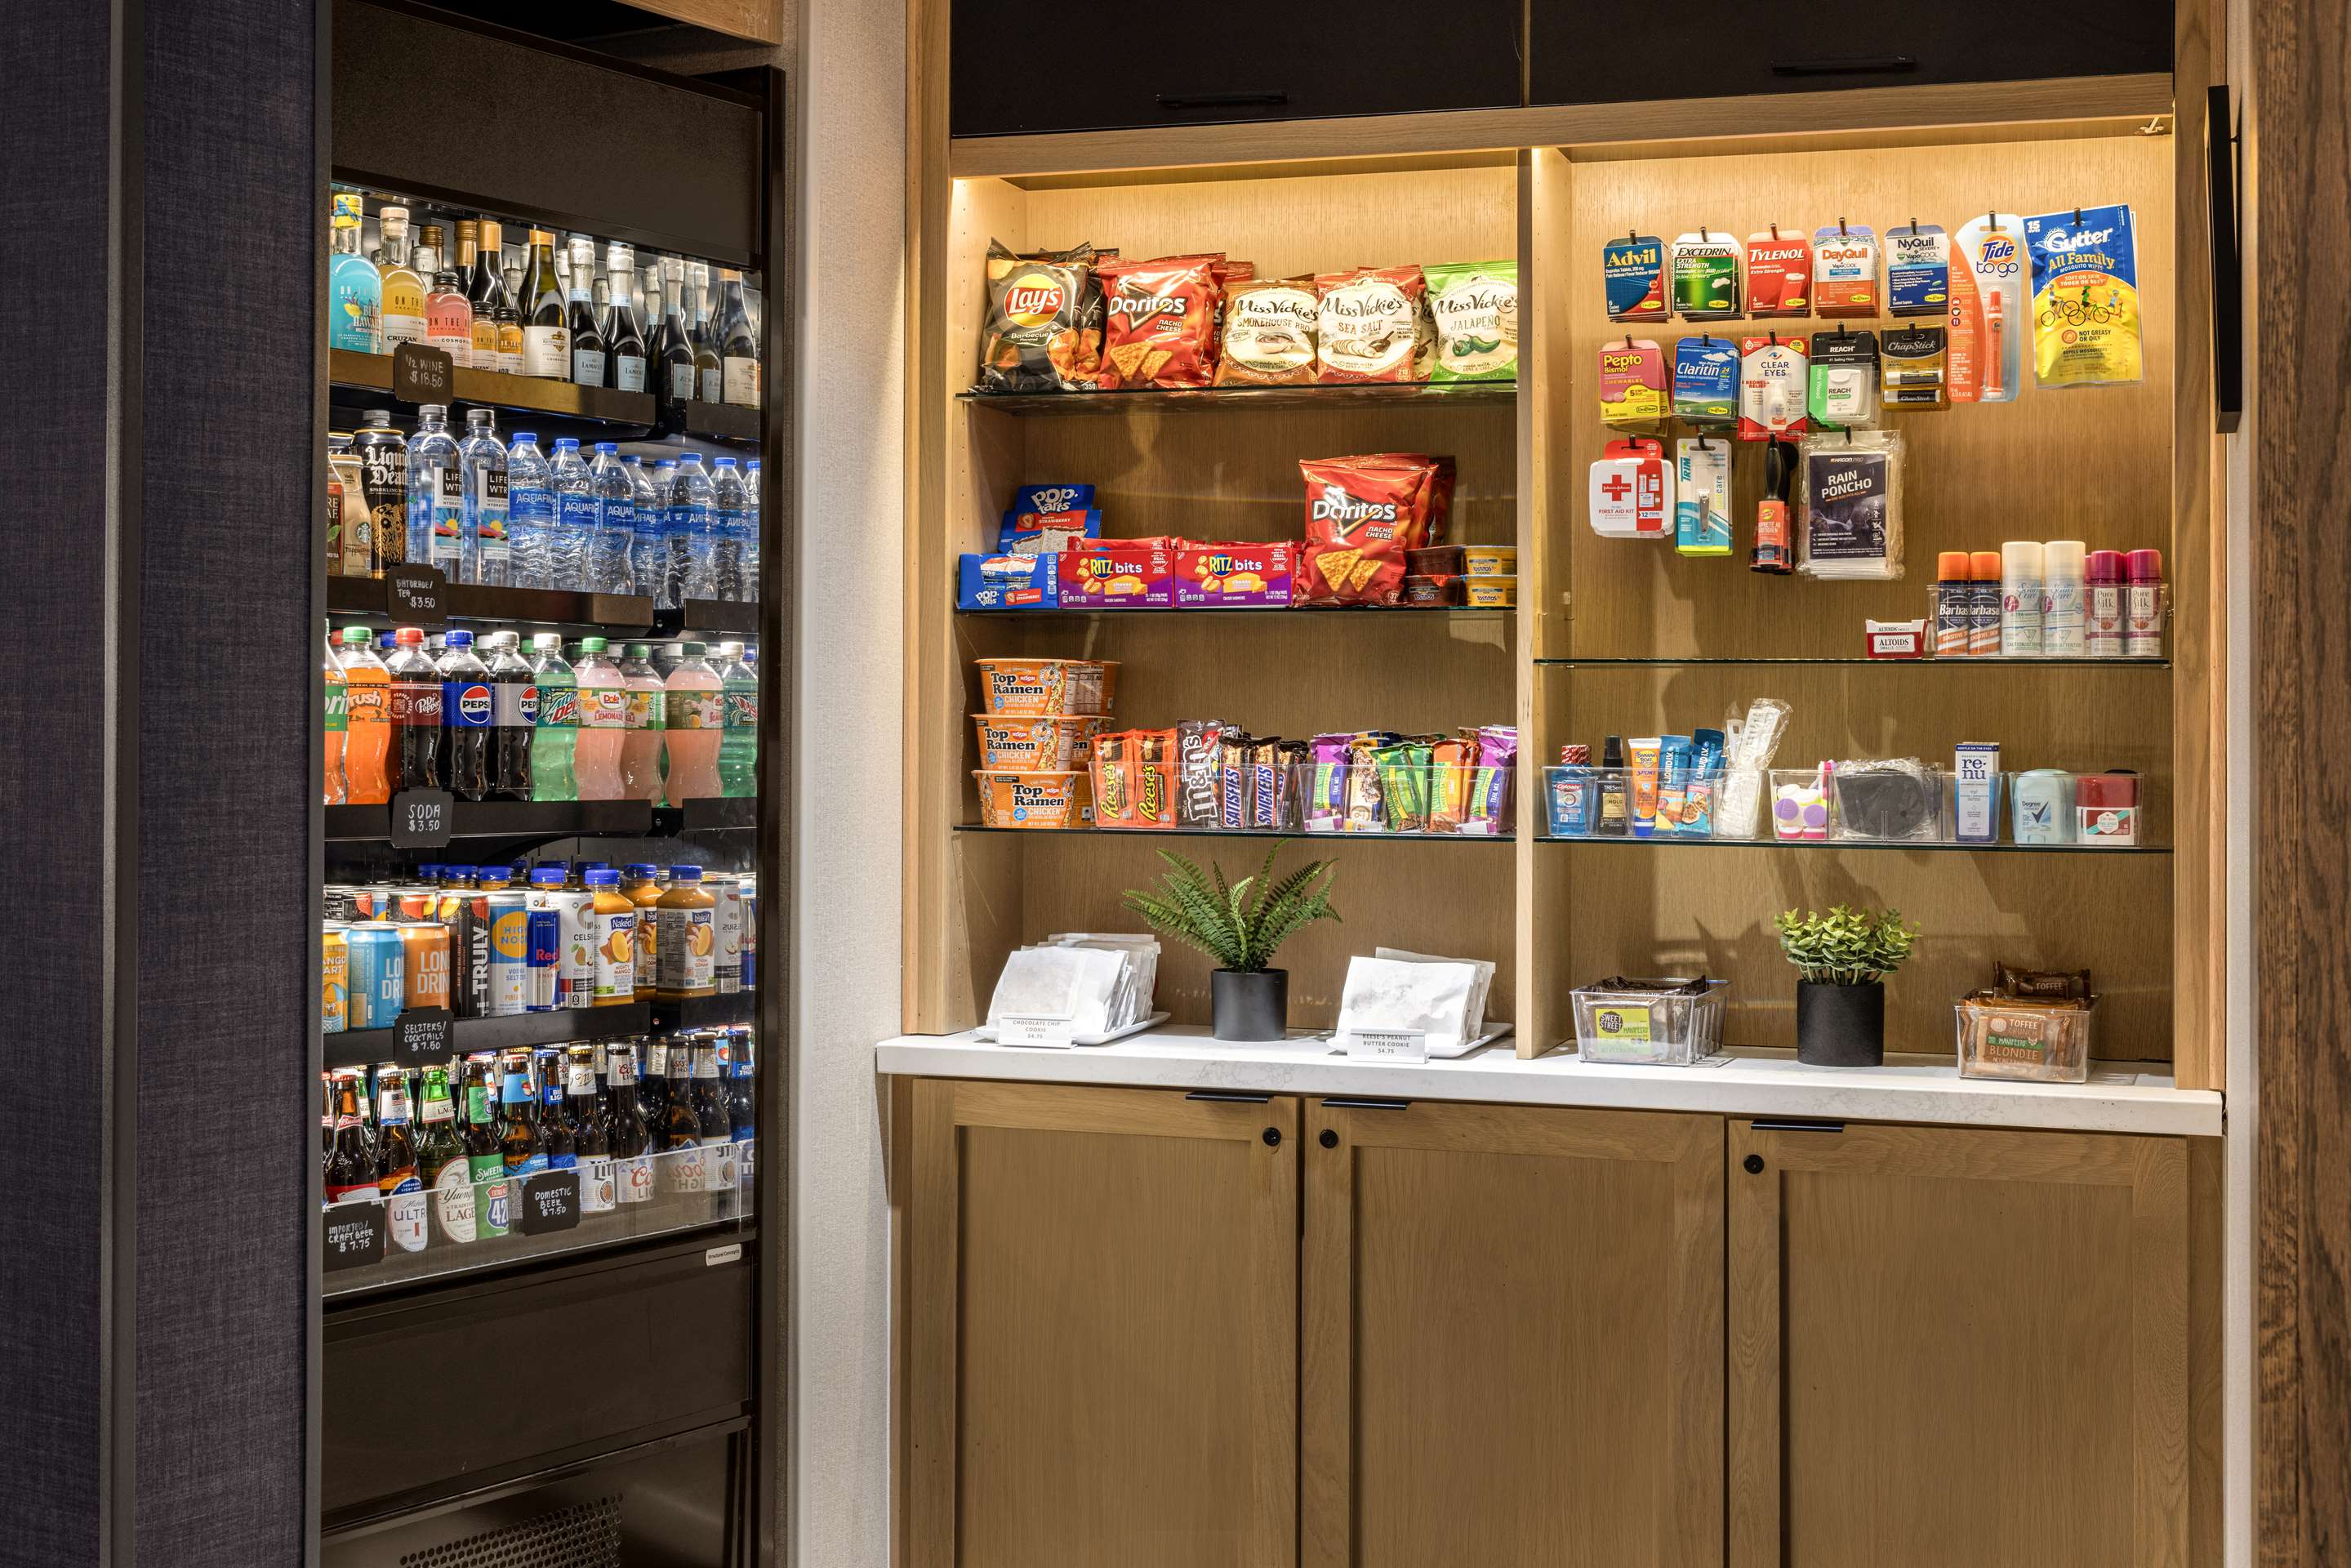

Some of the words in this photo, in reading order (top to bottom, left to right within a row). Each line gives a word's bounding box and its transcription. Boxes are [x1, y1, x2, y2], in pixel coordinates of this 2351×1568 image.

[2028, 220, 2040, 229] 15
[1898, 237, 1934, 251] NyQuil
[2046, 228, 2113, 252] Cutter
[1607, 248, 1657, 266] Advil
[1677, 248, 1731, 256] EXCEDRIN
[1749, 249, 1804, 262] TYLENOL
[1823, 248, 1868, 261] DayQuil
[1906, 252, 1939, 260] VapoCOOL
[1983, 241, 2015, 262] Tide
[2049, 255, 2065, 270] All
[2067, 253, 2115, 270] Family
[1976, 261, 1994, 273] to
[1997, 262, 2019, 278] go
[2060, 264, 2086, 273] MOSQUITO
[395, 296, 405, 305] ON
[1009, 287, 1058, 314] Lay's
[1109, 296, 1187, 315] Doritos
[1320, 297, 1358, 317] Miss
[1355, 294, 1403, 317] Vickie's
[1435, 301, 1471, 316] Miss
[1470, 290, 1517, 314] Vickie's
[1238, 300, 1271, 316] Miss
[1270, 300, 1319, 323] Vickie's
[429, 317, 439, 327] ON
[445, 318, 459, 327] THE
[1238, 318, 1293, 327] SMOKEHOUSE
[1338, 322, 1356, 335] SEA
[1360, 320, 1383, 333] SALT
[1888, 341, 1935, 351] ChapStick
[421, 359, 443, 372] WINE
[1603, 353, 1642, 367] Pepto
[1677, 363, 1720, 376] Claritin
[1681, 457, 1690, 482] TRIM
[490, 475, 507, 483] LIFE
[1828, 470, 1858, 486] RAIN
[490, 485, 508, 493] WTR
[1822, 478, 1872, 498] PONCHO
[1312, 499, 1398, 521] Doritos
[1365, 532, 1392, 540] CHEESE
[1369, 526, 1394, 534] NACHO
[1090, 559, 1113, 574] RITZ
[1115, 563, 1142, 574] bits
[1209, 557, 1233, 572] RITZ
[1235, 559, 1262, 571] bits
[398, 590, 411, 598] TEA
[2097, 590, 2114, 598] Pure
[409, 597, 436, 608] $3.50
[991, 673, 1016, 685] Top
[993, 684, 1044, 695] Ramen
[350, 690, 381, 706] rush
[1005, 695, 1039, 703] CHICKEN
[985, 728, 1009, 740] Top
[986, 739, 1036, 750] Ramen
[997, 751, 1031, 759] CHICKEN
[1664, 761, 1672, 784] LIQUID
[1962, 769, 1986, 779] nu
[1013, 785, 1043, 798] Top
[1224, 768, 1241, 827] SATISFIES
[1257, 765, 1273, 825] SNICKERS
[1013, 796, 1064, 807] Ramen
[408, 804, 441, 819] SODA
[1028, 807, 1061, 815] CHICKEN
[408, 820, 440, 831] $3.50
[612, 918, 632, 929] Naked
[472, 926, 488, 996] TRULY
[2036, 982, 2064, 991] TOFFEE
[1601, 1013, 1622, 1023] SWEET
[2010, 1018, 2039, 1029] TOFFEE
[404, 1021, 447, 1034] SELZTERS/
[1600, 1021, 1622, 1030] STREET
[404, 1032, 443, 1043] COCKTAILS
[1998, 1037, 2027, 1046] MANIFESTO
[411, 1042, 441, 1051] $7.50
[1989, 1045, 2038, 1059] BLONDIE
[535, 1186, 572, 1200] DOMESTIC
[540, 1199, 562, 1209] BEER
[447, 1208, 475, 1222] LAGE
[328, 1232, 353, 1243] CRAFT
[354, 1230, 373, 1241] BEER
